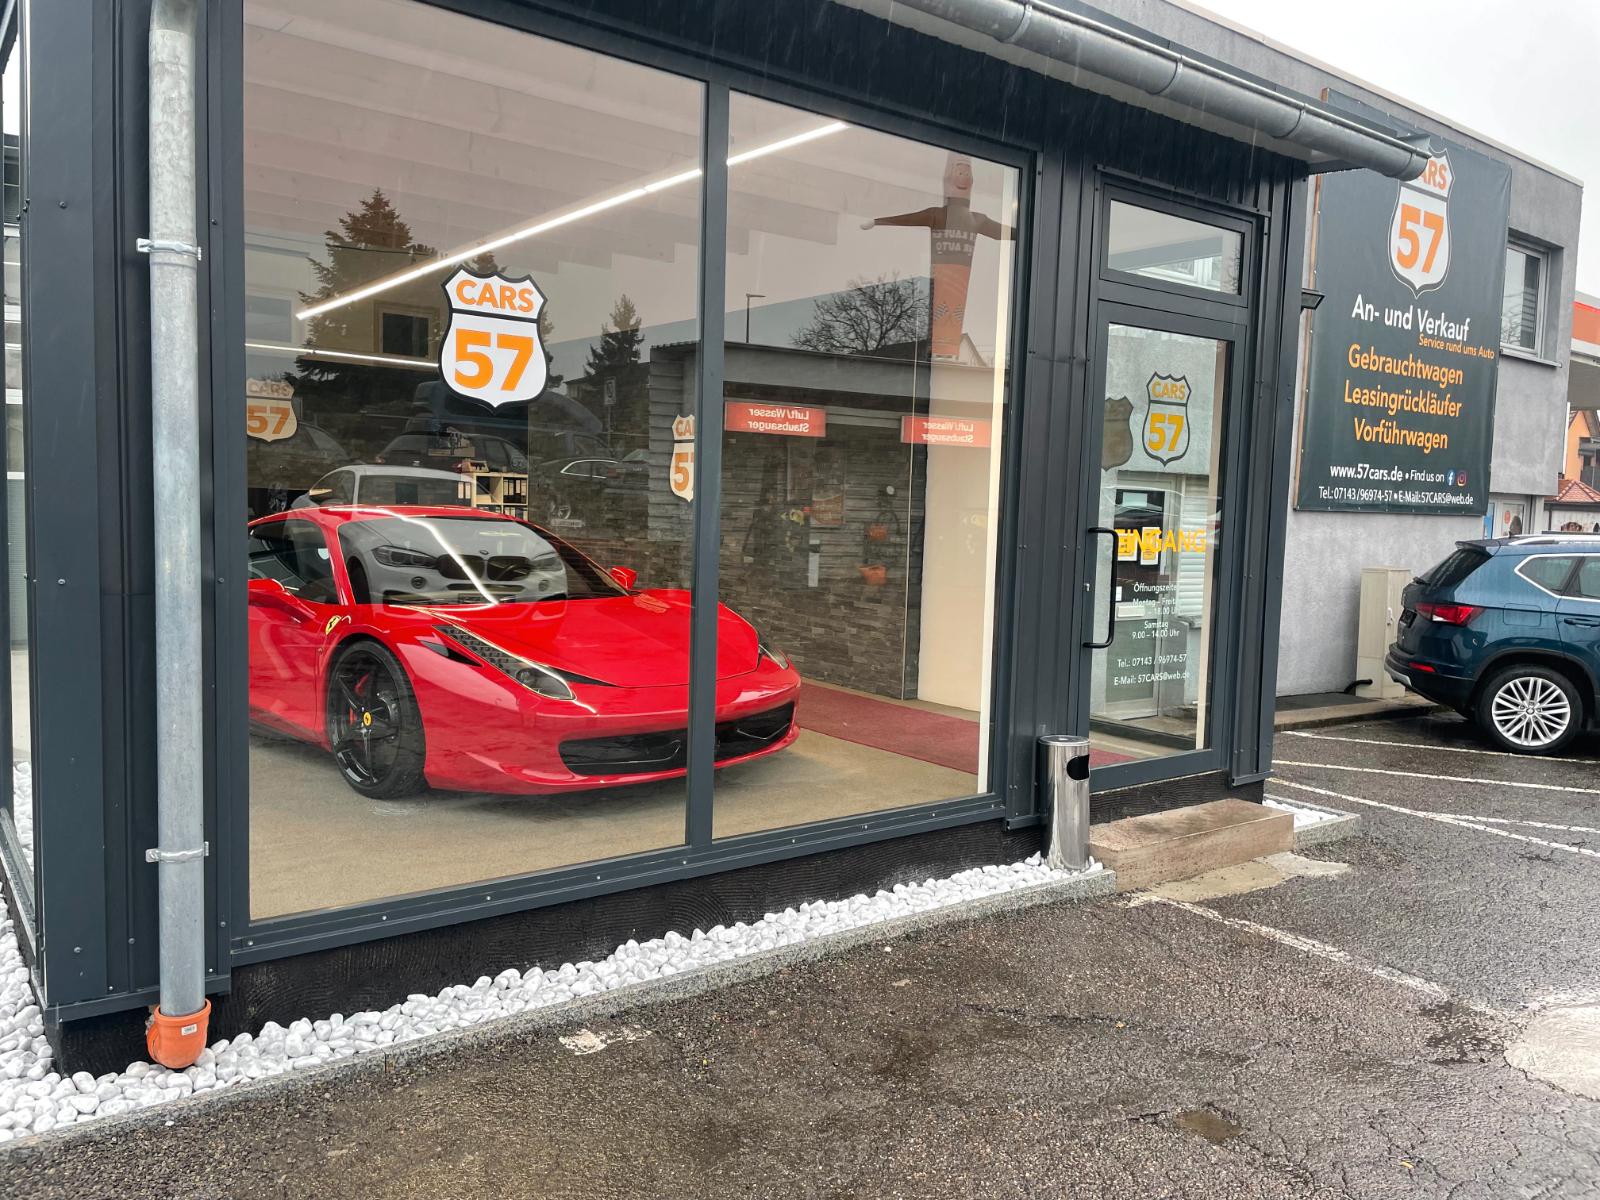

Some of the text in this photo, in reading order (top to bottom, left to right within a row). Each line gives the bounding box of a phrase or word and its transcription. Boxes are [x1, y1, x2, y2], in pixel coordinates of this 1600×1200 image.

[1396, 203, 1445, 274] 57
[455, 279, 534, 313] CARS
[1351, 294, 1471, 342] An- und Verkauf
[454, 327, 534, 392] 57
[1418, 333, 1495, 359] Service rund ums Auto
[1348, 343, 1463, 389] Gebrauchtwagen
[1151, 380, 1185, 401] CARS
[1344, 379, 1463, 418] Leasingrückläufer
[247, 404, 291, 435] 57
[675, 419, 695, 437] CA
[1147, 412, 1185, 452] 57
[1353, 417, 1449, 454] Vorführwagen
[1330, 463, 1403, 481] www.57cars.de
[1409, 469, 1427, 482] Find
[1427, 473, 1435, 482] us
[1435, 474, 1445, 483] on
[1114, 527, 1207, 553] EINGANG
[1133, 582, 1177, 594] Öffnungszeite
[1132, 631, 1146, 639] 9.00
[1169, 628, 1180, 637] Uhr
[1131, 656, 1153, 667] 07143
[1158, 653, 1188, 664] 96974-57
[1113, 675, 1137, 686] E-Mail:
